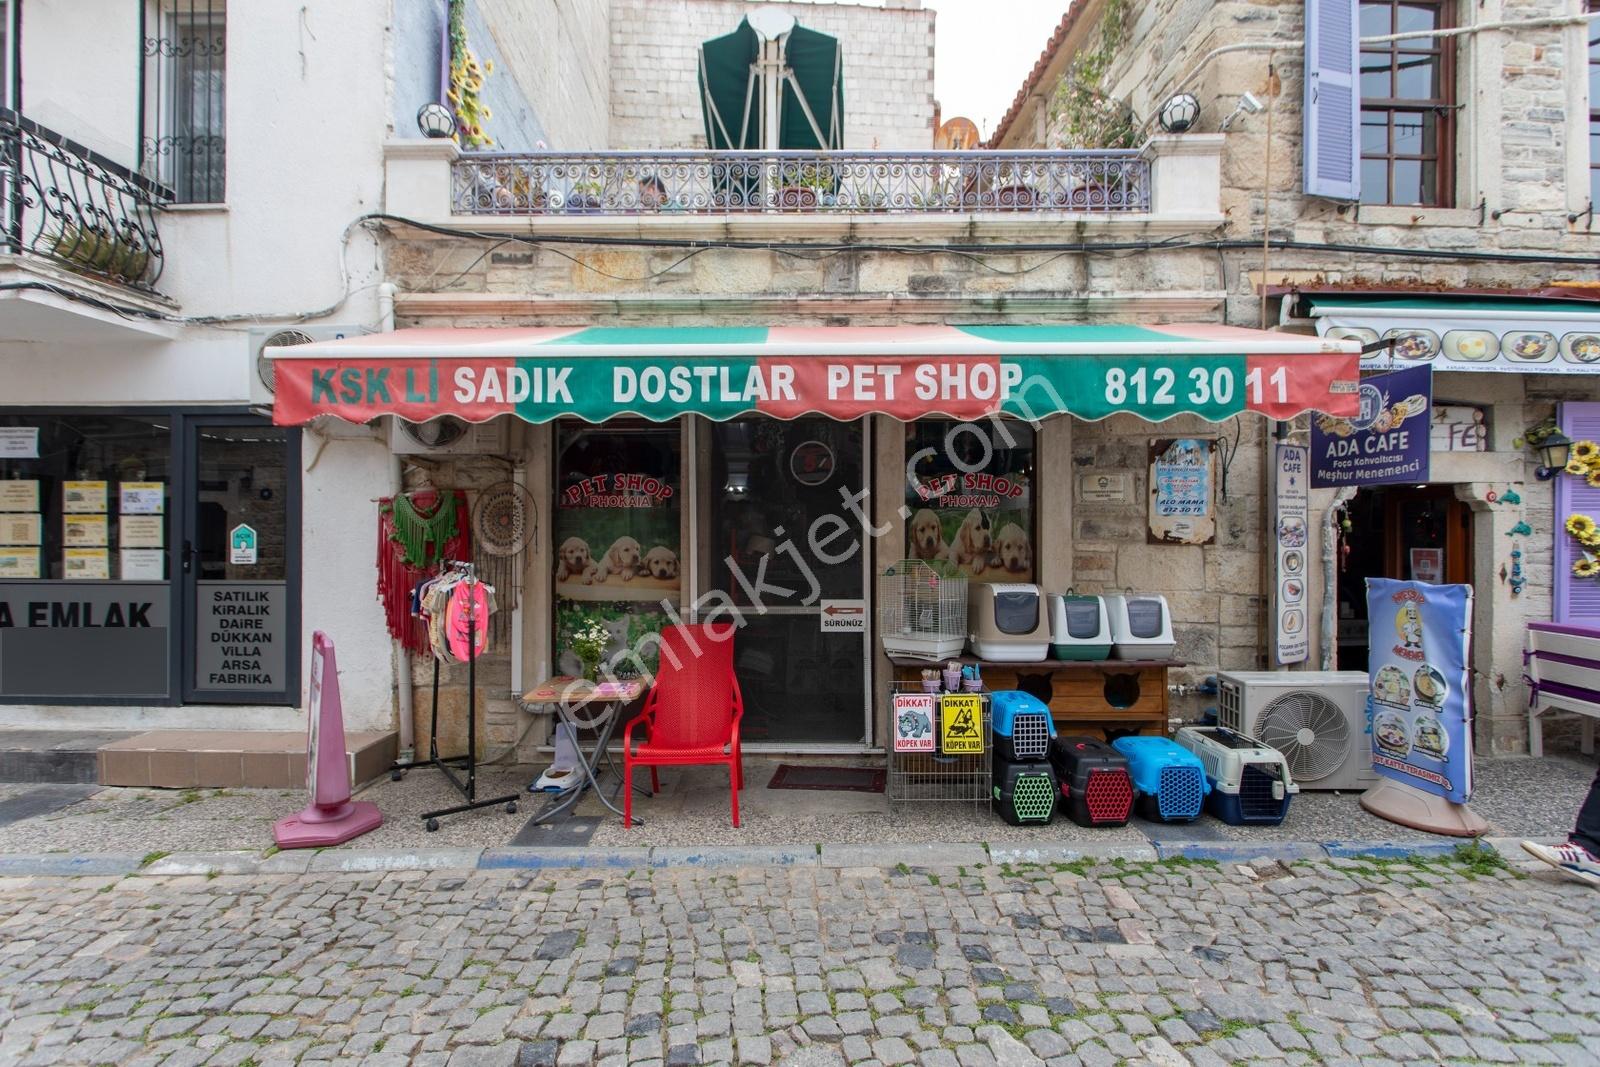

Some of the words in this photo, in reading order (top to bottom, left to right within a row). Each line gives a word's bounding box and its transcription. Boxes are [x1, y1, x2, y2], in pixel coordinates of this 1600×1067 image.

[312, 367, 391, 404] KSK
[454, 366, 574, 404] SADIK
[613, 364, 797, 403] DOSTLAR
[828, 364, 901, 401] PET
[915, 363, 1024, 401] SHOP
[1105, 367, 1175, 405] 812
[1188, 367, 1235, 405] 30
[1246, 366, 1288, 404] 11
[1326, 439, 1359, 458] ADA
[1364, 431, 1409, 454] CAFE
[1284, 449, 1301, 461] ADA
[1283, 463, 1302, 473] CAFE
[1333, 459, 1352, 469] Foça
[1318, 469, 1353, 482] Meşhur
[1355, 459, 1420, 479] Menemenci
[567, 474, 608, 503] PET
[614, 473, 674, 501] SHOP
[917, 473, 958, 501] PET
[964, 472, 1024, 499] SHOP
[589, 495, 652, 508] PHOKAIA
[940, 495, 1000, 508] PHOKAIA
[214, 591, 269, 602] SATILIK
[29, 602, 153, 628] EMLAK
[212, 604, 270, 616] KİRALIK
[219, 619, 263, 629] DAİRE
[824, 619, 863, 627] SÜRÜNÜZ
[211, 629, 272, 643] DÜKKAN
[222, 646, 261, 656] VİLLA
[222, 660, 261, 670] ARSA
[209, 673, 272, 684] FABRİKA
[897, 740, 918, 748] KÖPEK
[920, 740, 932, 748] VAR
[946, 741, 967, 750] KÖPEK
[968, 741, 981, 749] VAR
